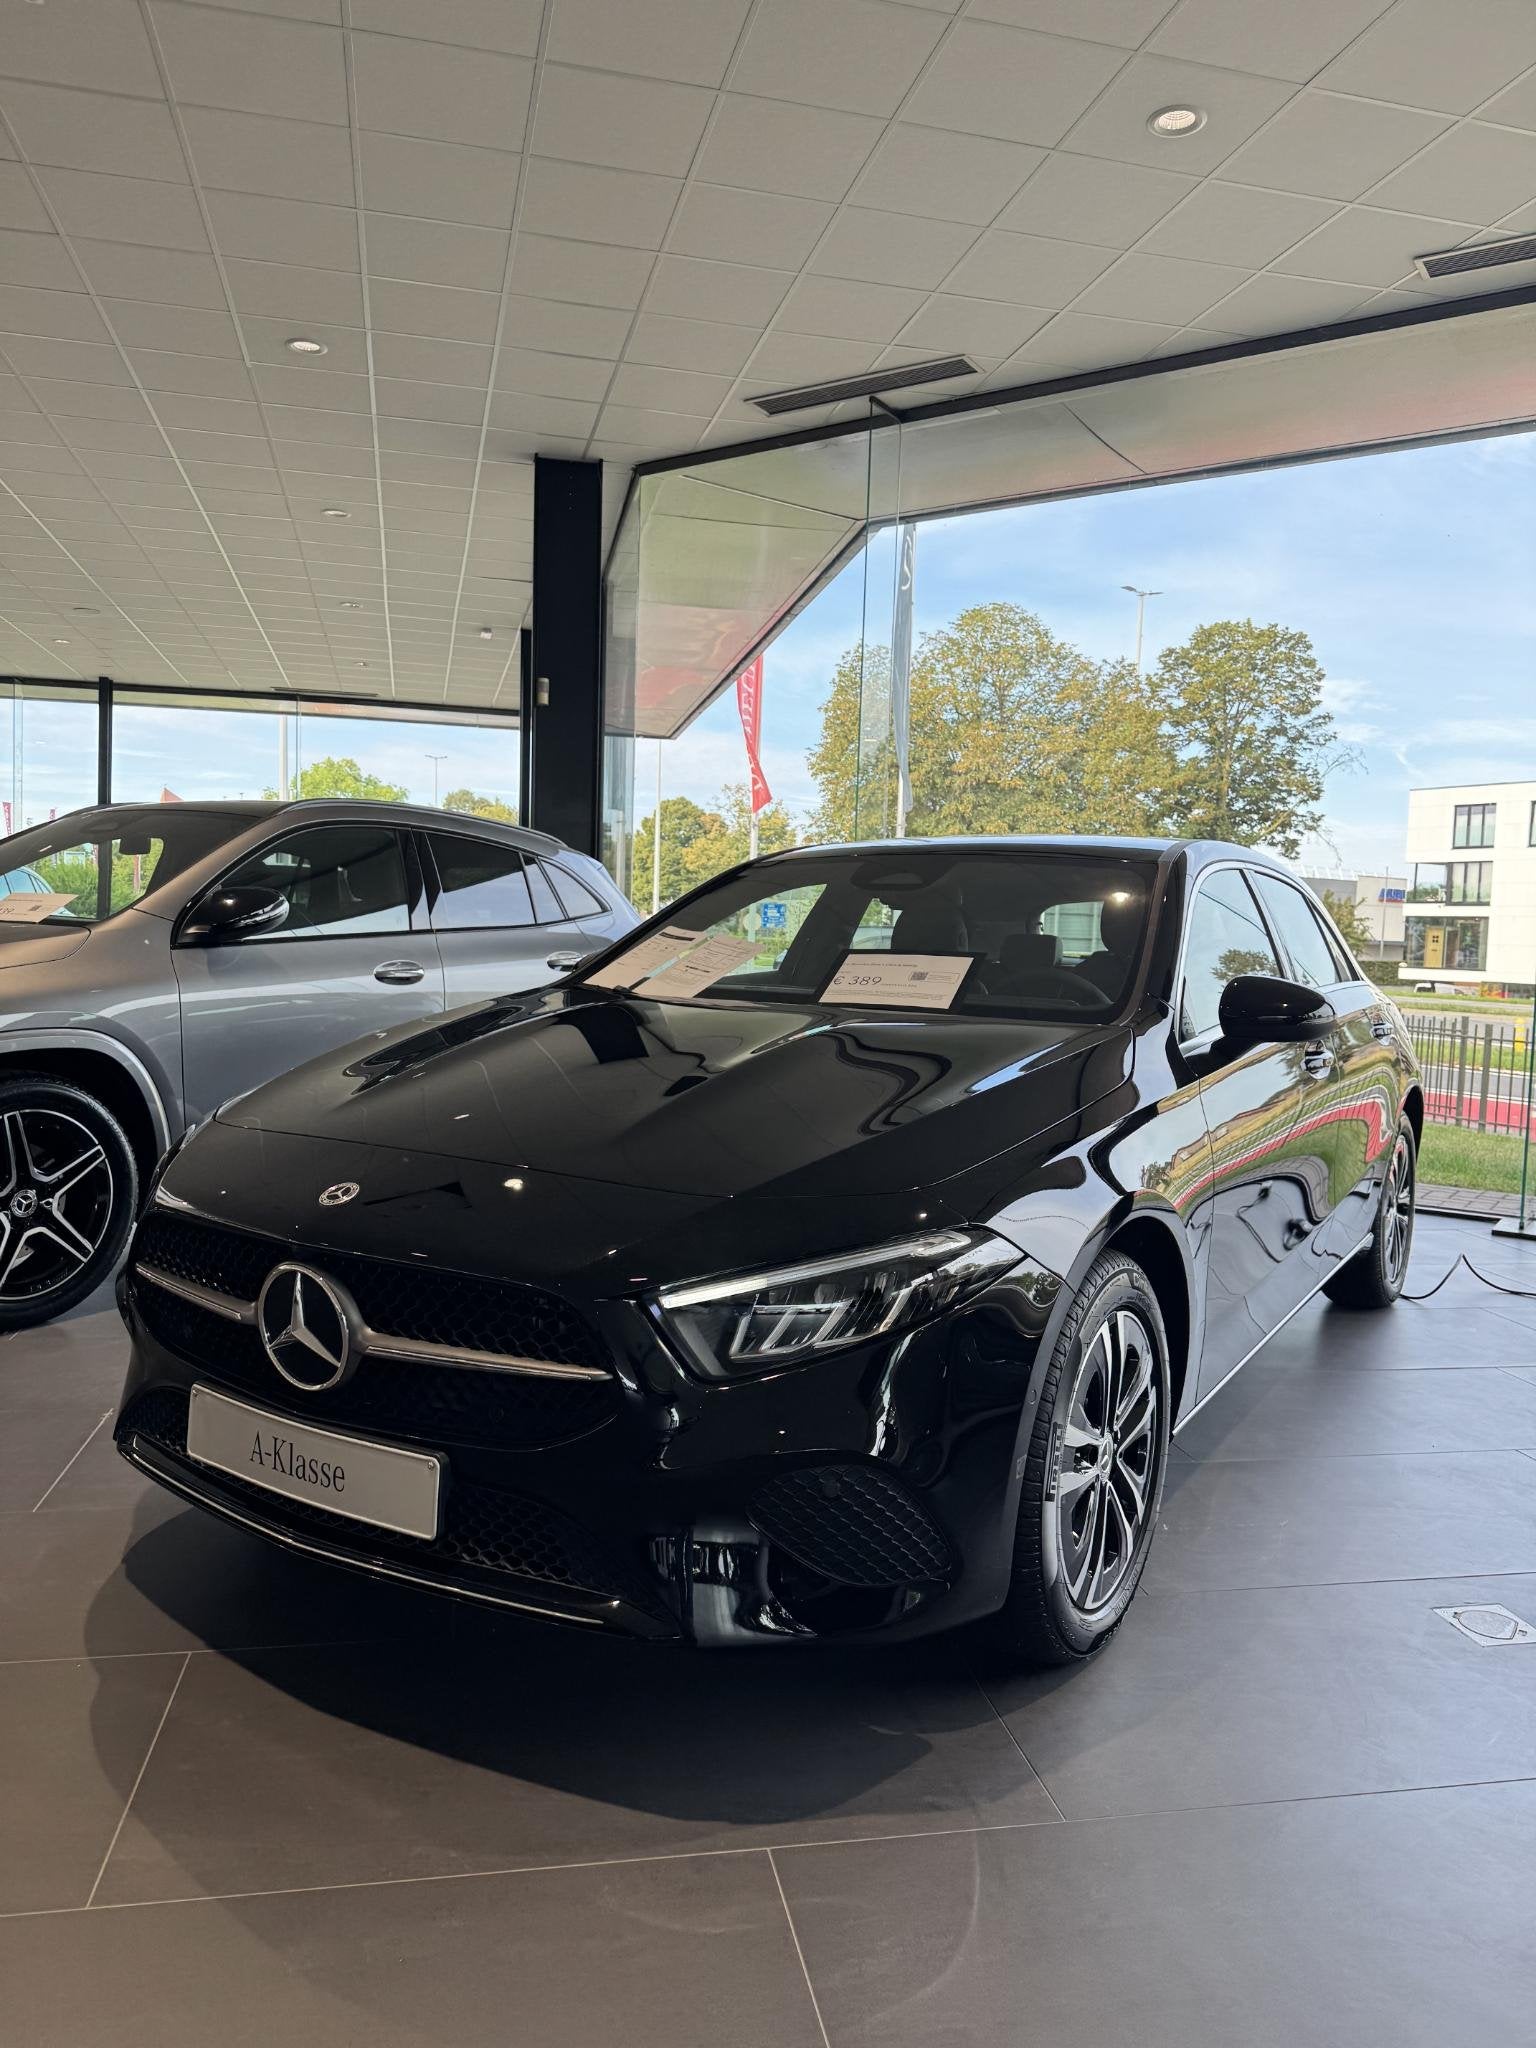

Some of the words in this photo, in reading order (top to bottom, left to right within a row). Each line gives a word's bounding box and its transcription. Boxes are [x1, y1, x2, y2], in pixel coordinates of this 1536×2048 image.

[834, 976, 845, 985] €
[848, 975, 882, 986] 389
[249, 1429, 346, 1493] A-Klasse
